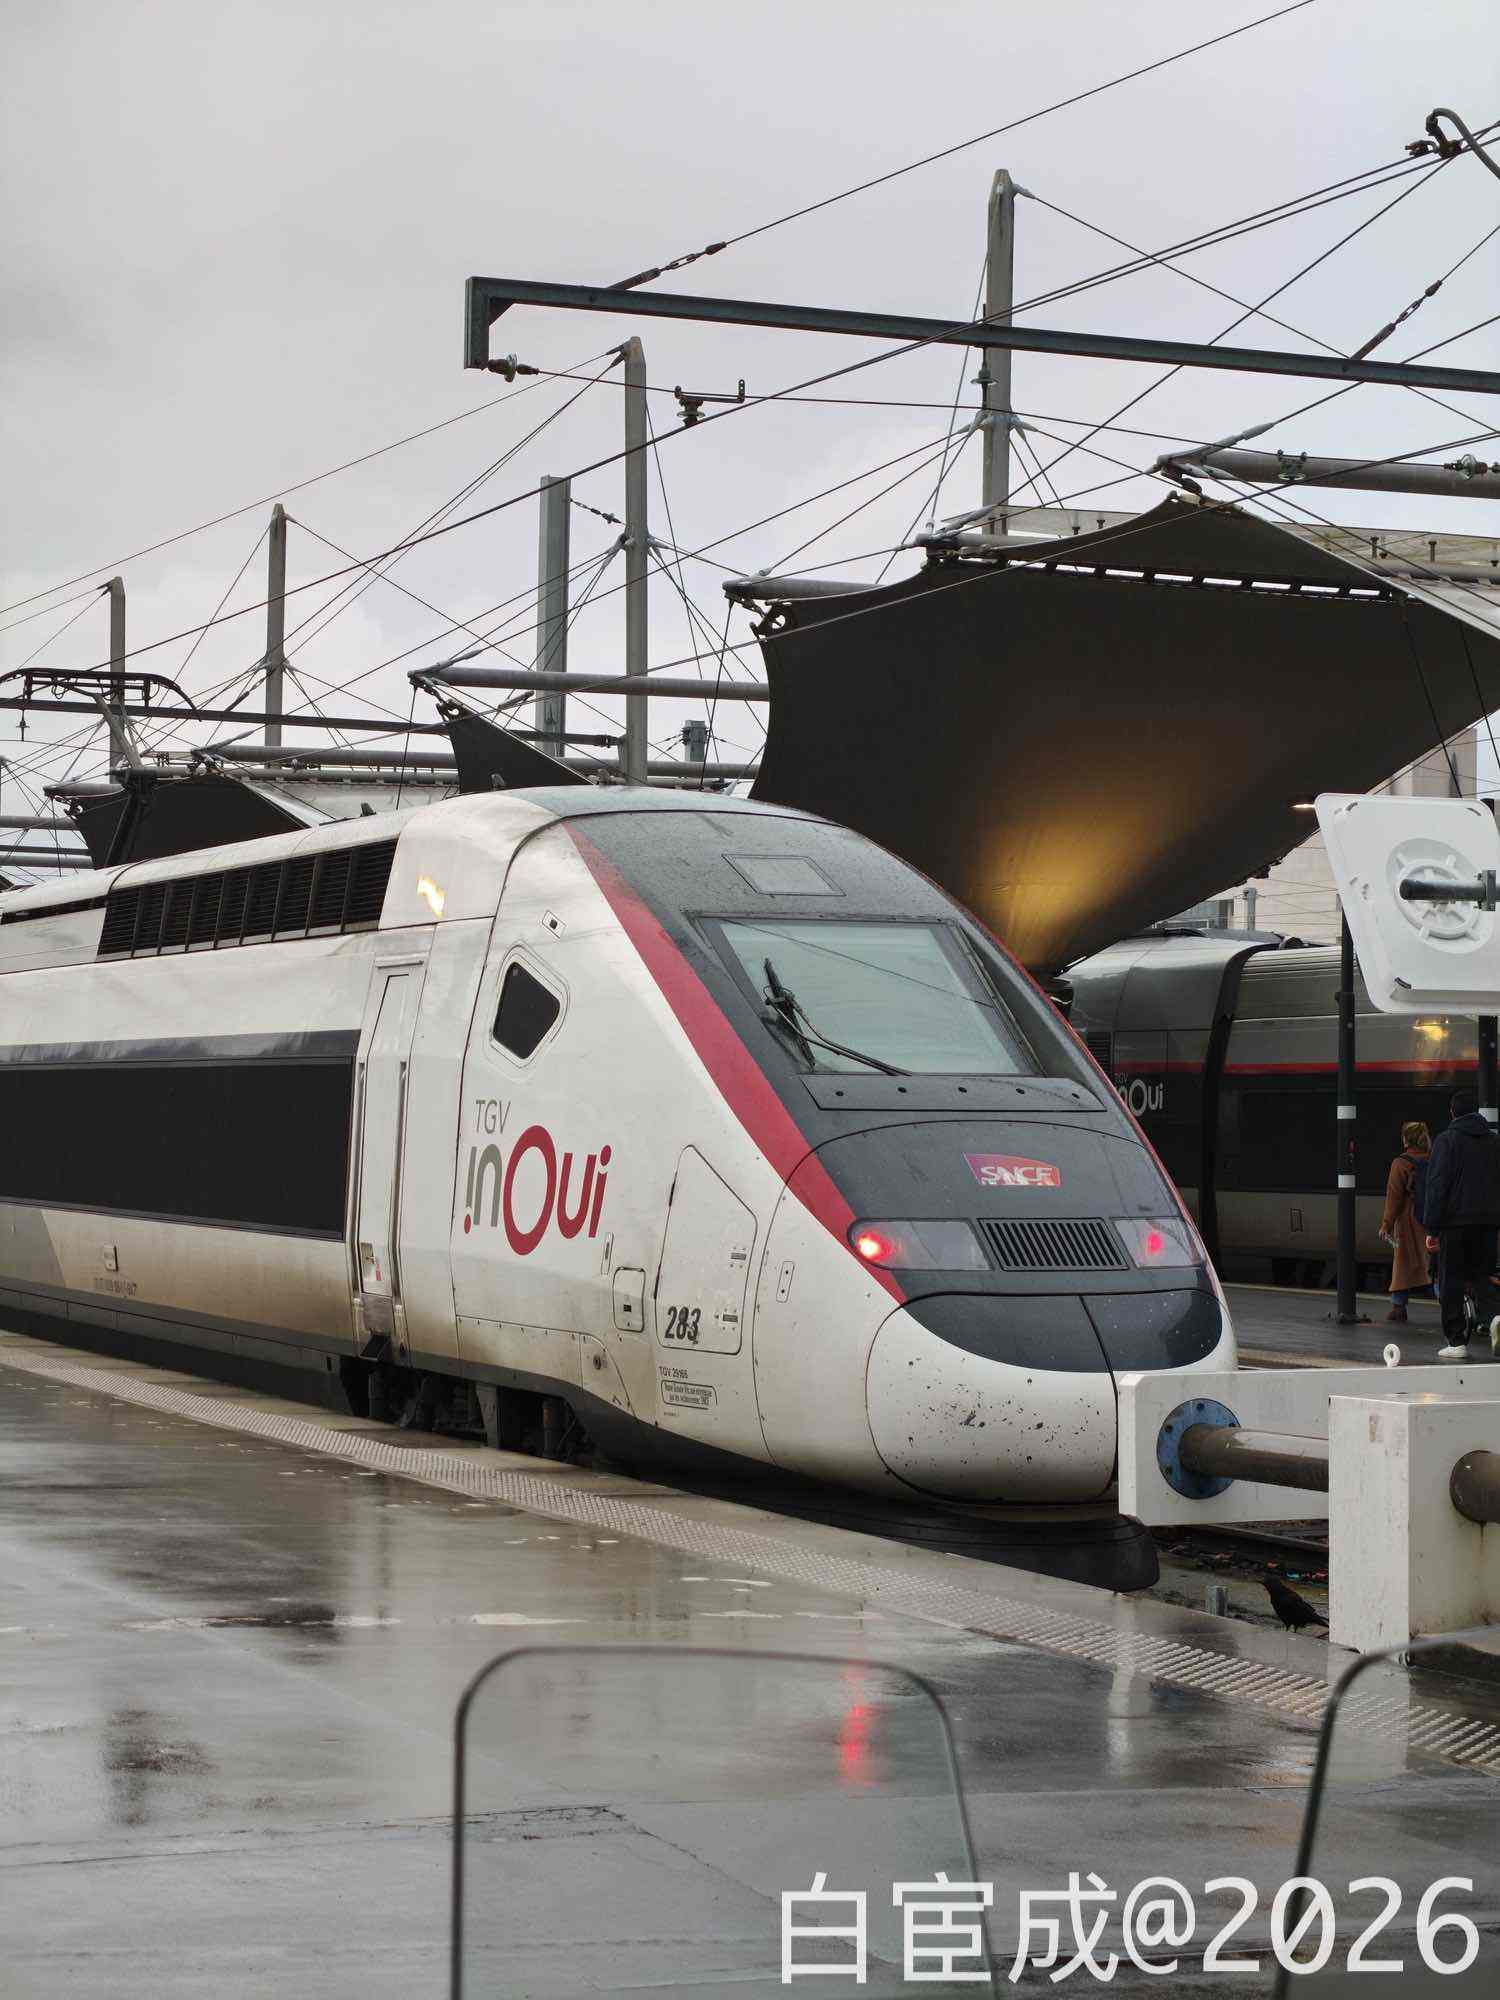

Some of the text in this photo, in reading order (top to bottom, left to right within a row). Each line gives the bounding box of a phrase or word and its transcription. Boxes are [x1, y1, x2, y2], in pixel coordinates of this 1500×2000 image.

[1118, 1079, 1164, 1117] nOui
[475, 1099, 511, 1134] TGV
[980, 1166, 1055, 1187] SNCF
[664, 1306, 701, 1341] 283
